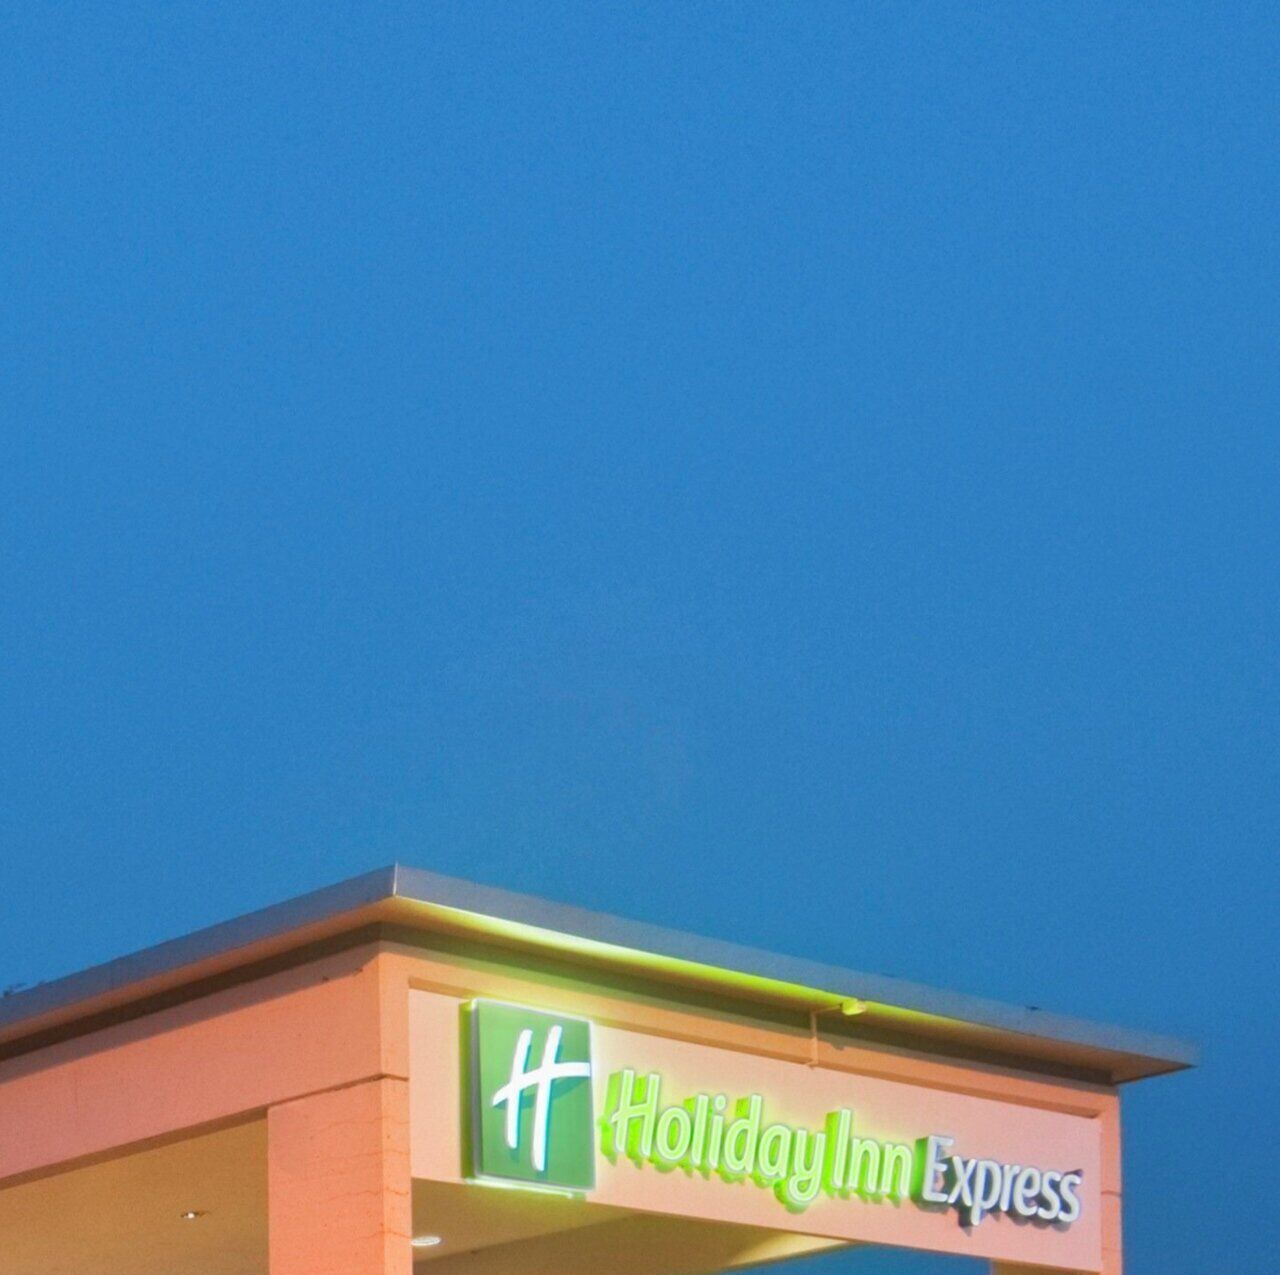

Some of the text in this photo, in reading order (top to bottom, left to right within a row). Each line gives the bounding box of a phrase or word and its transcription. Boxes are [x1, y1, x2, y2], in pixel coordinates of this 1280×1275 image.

[492, 1025, 592, 1172] H
[608, 1068, 1082, 1226] Holiday Inn Express
